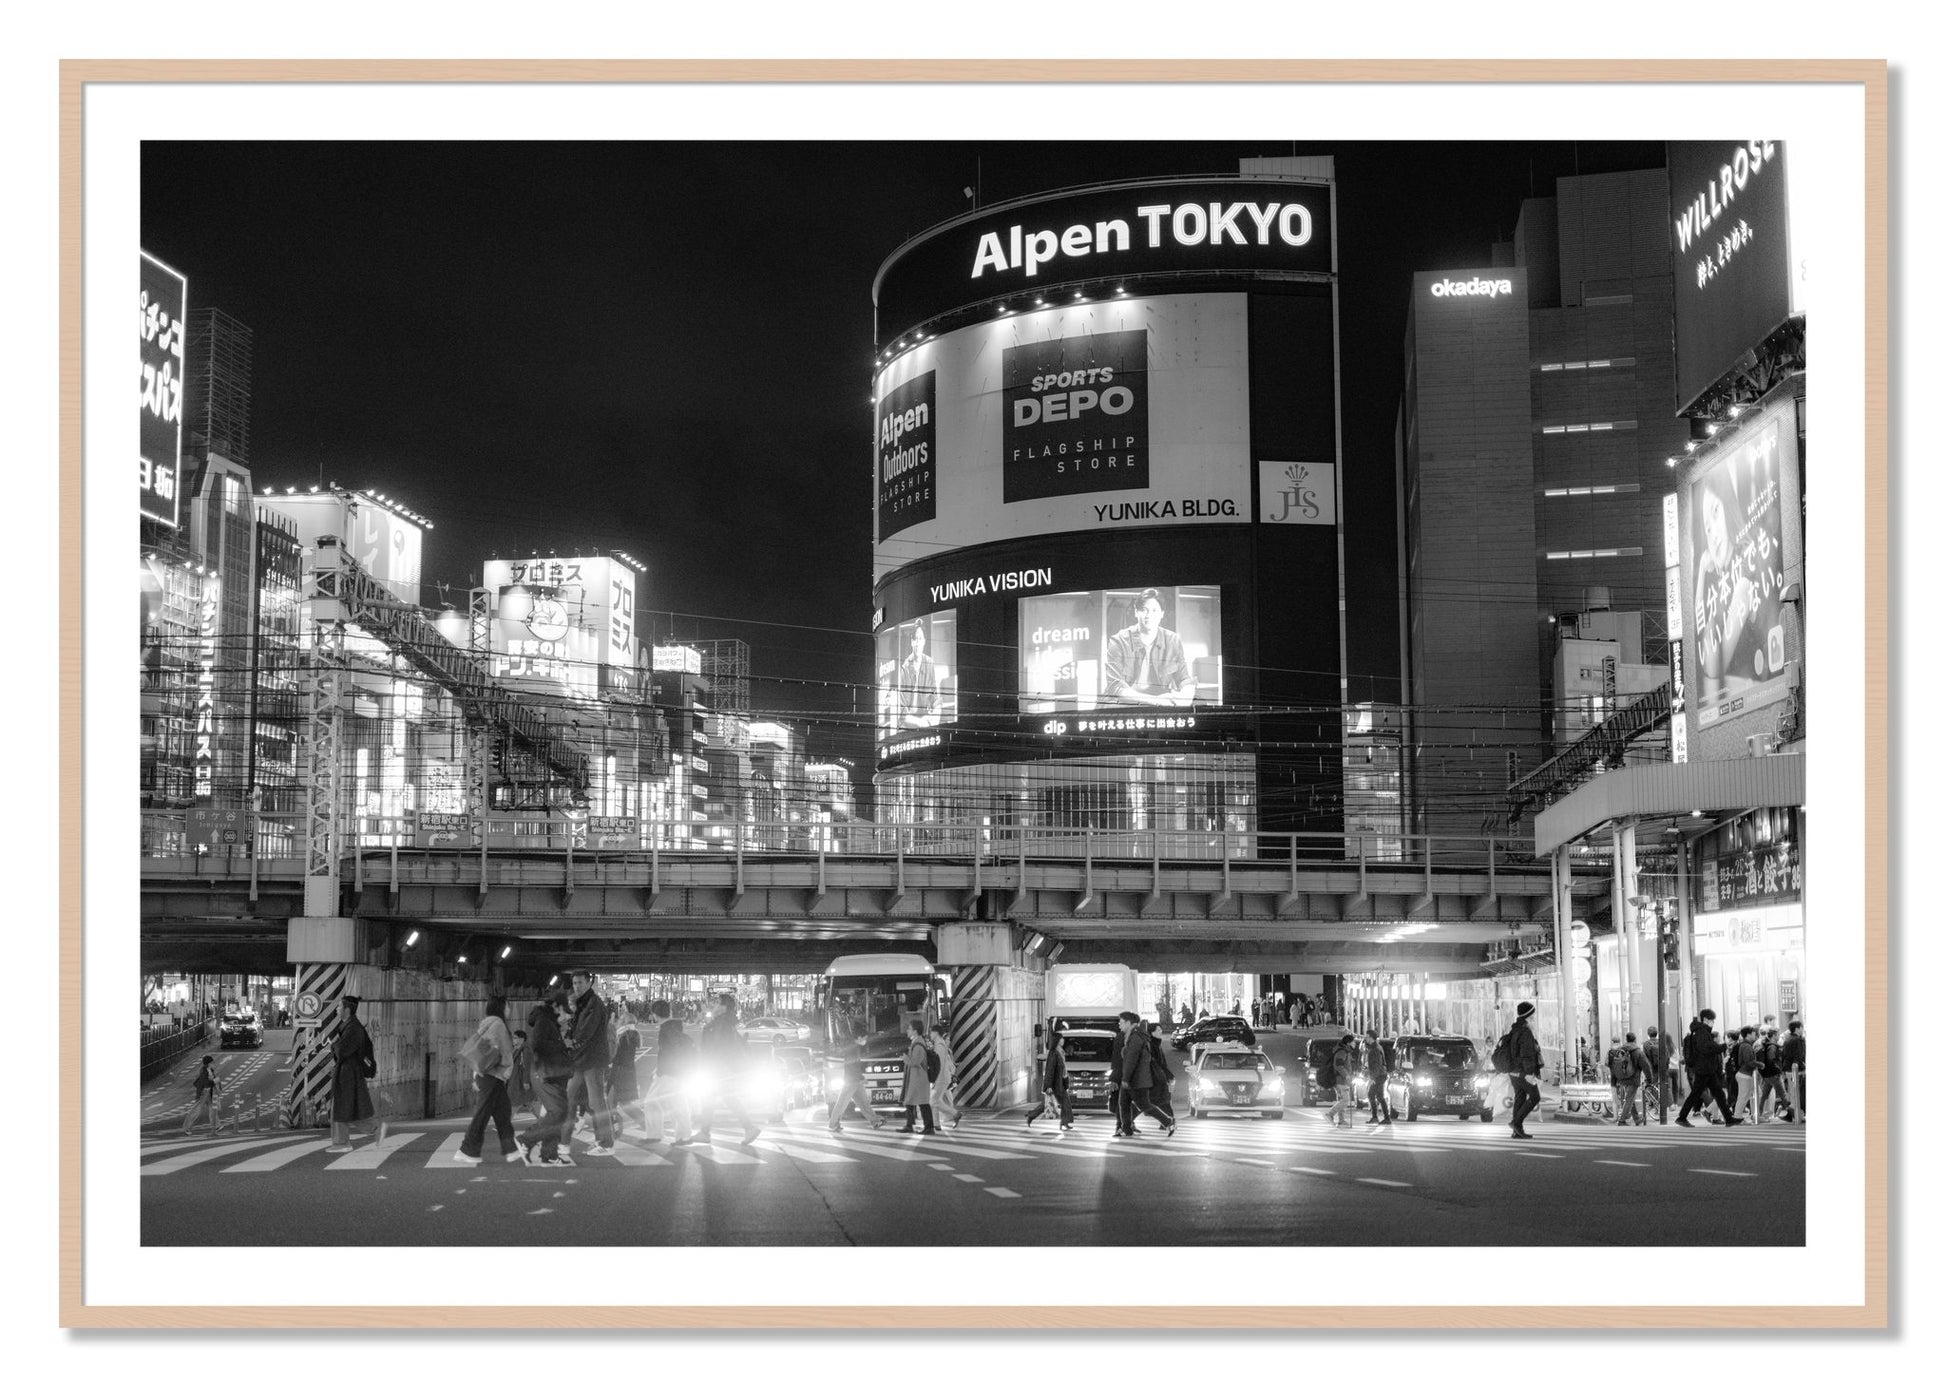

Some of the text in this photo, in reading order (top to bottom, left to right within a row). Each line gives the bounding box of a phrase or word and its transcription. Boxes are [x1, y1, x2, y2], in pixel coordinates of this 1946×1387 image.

[971, 202, 1312, 279] Alpen TOKYO
[1431, 277, 1512, 298] okadaya
[1031, 366, 1114, 393] SPORTS
[1014, 386, 1134, 428] DEPO
[881, 402, 929, 450] Alpen
[1013, 436, 1135, 462] FLAGSHIP
[883, 441, 928, 483] Outdoors
[1057, 455, 1135, 473] STORE
[880, 471, 929, 505] FLAGSHIP
[893, 488, 929, 513] STORE
[1093, 499, 1240, 522] YUNIKA BLDG.
[266, 568, 298, 590] SHISHA
[510, 563, 583, 583] プロミス
[930, 567, 1051, 603] YUNIKA VISION
[1032, 626, 1089, 644] dream
[1043, 720, 1067, 735] dip
